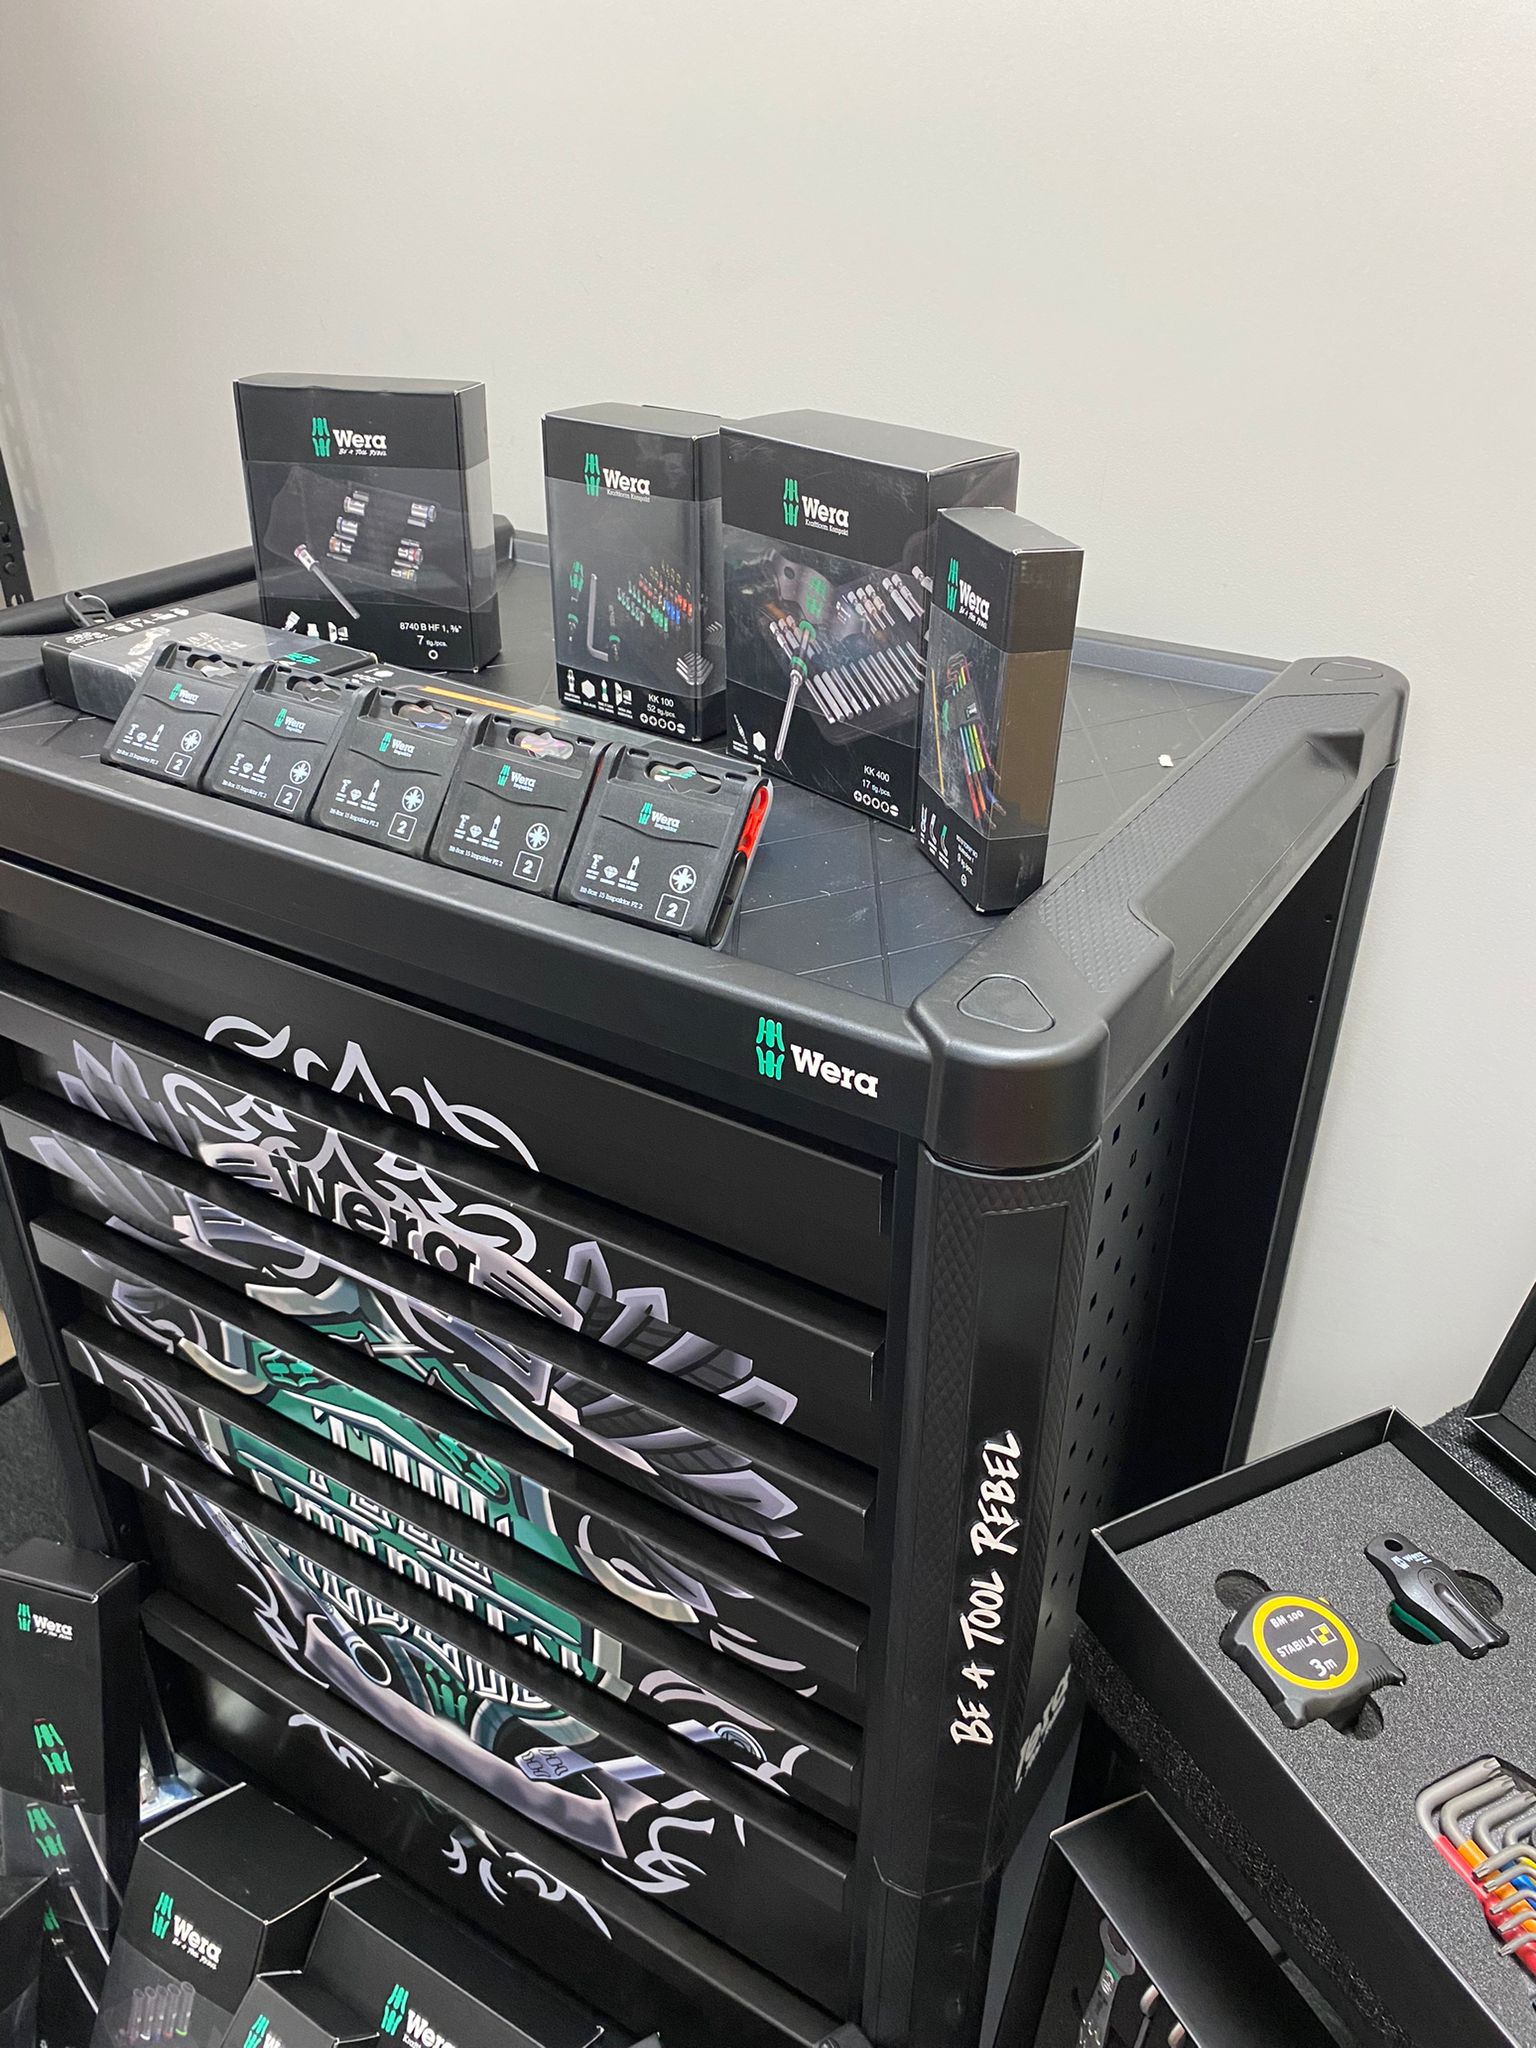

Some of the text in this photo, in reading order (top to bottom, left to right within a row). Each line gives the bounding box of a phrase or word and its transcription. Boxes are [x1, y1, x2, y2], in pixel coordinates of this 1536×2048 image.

[332, 429, 387, 449] Wera
[602, 467, 650, 496] Wera
[801, 495, 849, 528] Wera
[959, 579, 990, 621] Wera
[399, 622, 419, 631] 8740
[420, 622, 427, 631] B
[428, 623, 440, 632] HF
[416, 634, 425, 645] 7
[646, 703, 656, 713] 52
[648, 693, 675, 708] KK 100
[284, 715, 306, 730] Wera
[391, 738, 416, 754] Wera
[511, 771, 537, 788] Wera
[862, 778, 871, 788] 17
[863, 765, 890, 783] KK 400
[282, 791, 293, 805] 2
[396, 820, 408, 834] 2
[651, 810, 681, 828] Wera
[521, 859, 534, 875] 2
[665, 902, 678, 918] 2
[790, 1043, 879, 1098] Wera
[268, 1154, 480, 1283] Wera
[950, 1429, 1021, 1745] BE A TOOL REBEL
[32, 1613, 73, 1636] Wera
[1270, 1609, 1305, 1629] BM 100
[1276, 1635, 1317, 1658] STABILA
[174, 1914, 222, 1964] Wera
